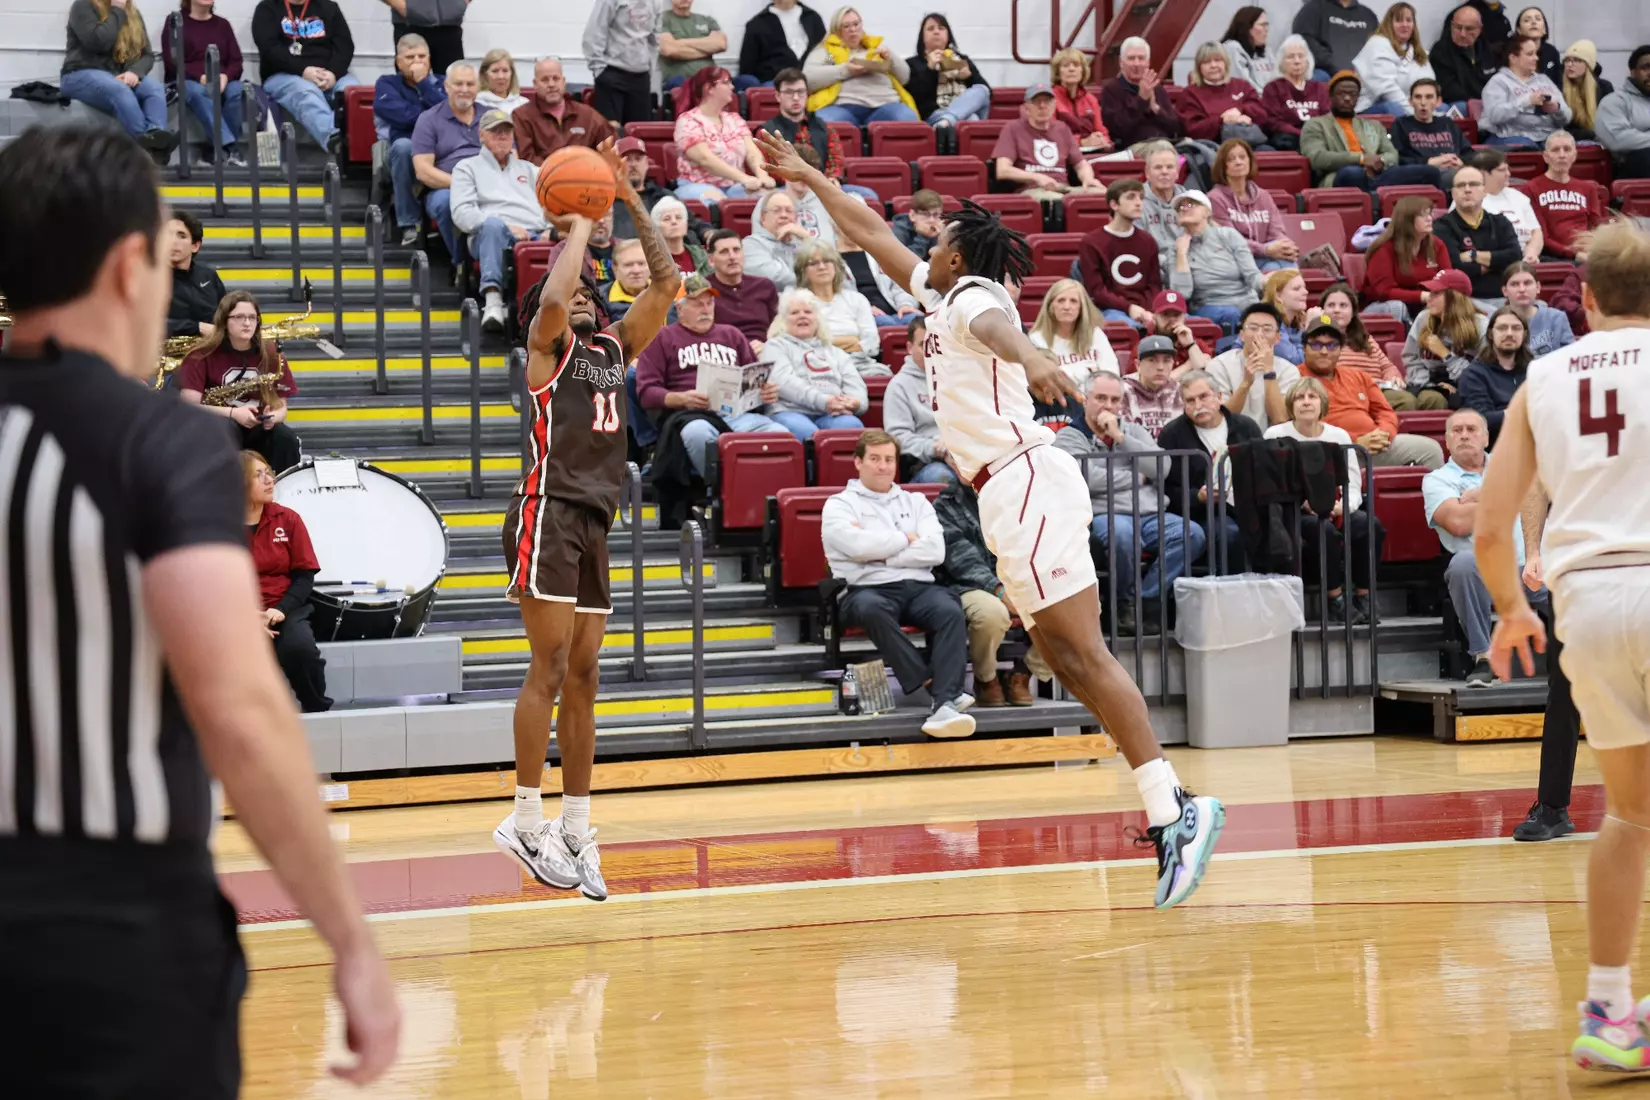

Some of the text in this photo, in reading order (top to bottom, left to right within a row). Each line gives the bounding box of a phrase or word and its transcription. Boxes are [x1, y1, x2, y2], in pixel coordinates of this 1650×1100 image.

[1539, 189, 1588, 209] COLGATE
[1111, 253, 1143, 286] C
[677, 342, 738, 369] COLGATE
[1568, 348, 1641, 373] MOFFATT
[1578, 377, 1626, 458] 4
